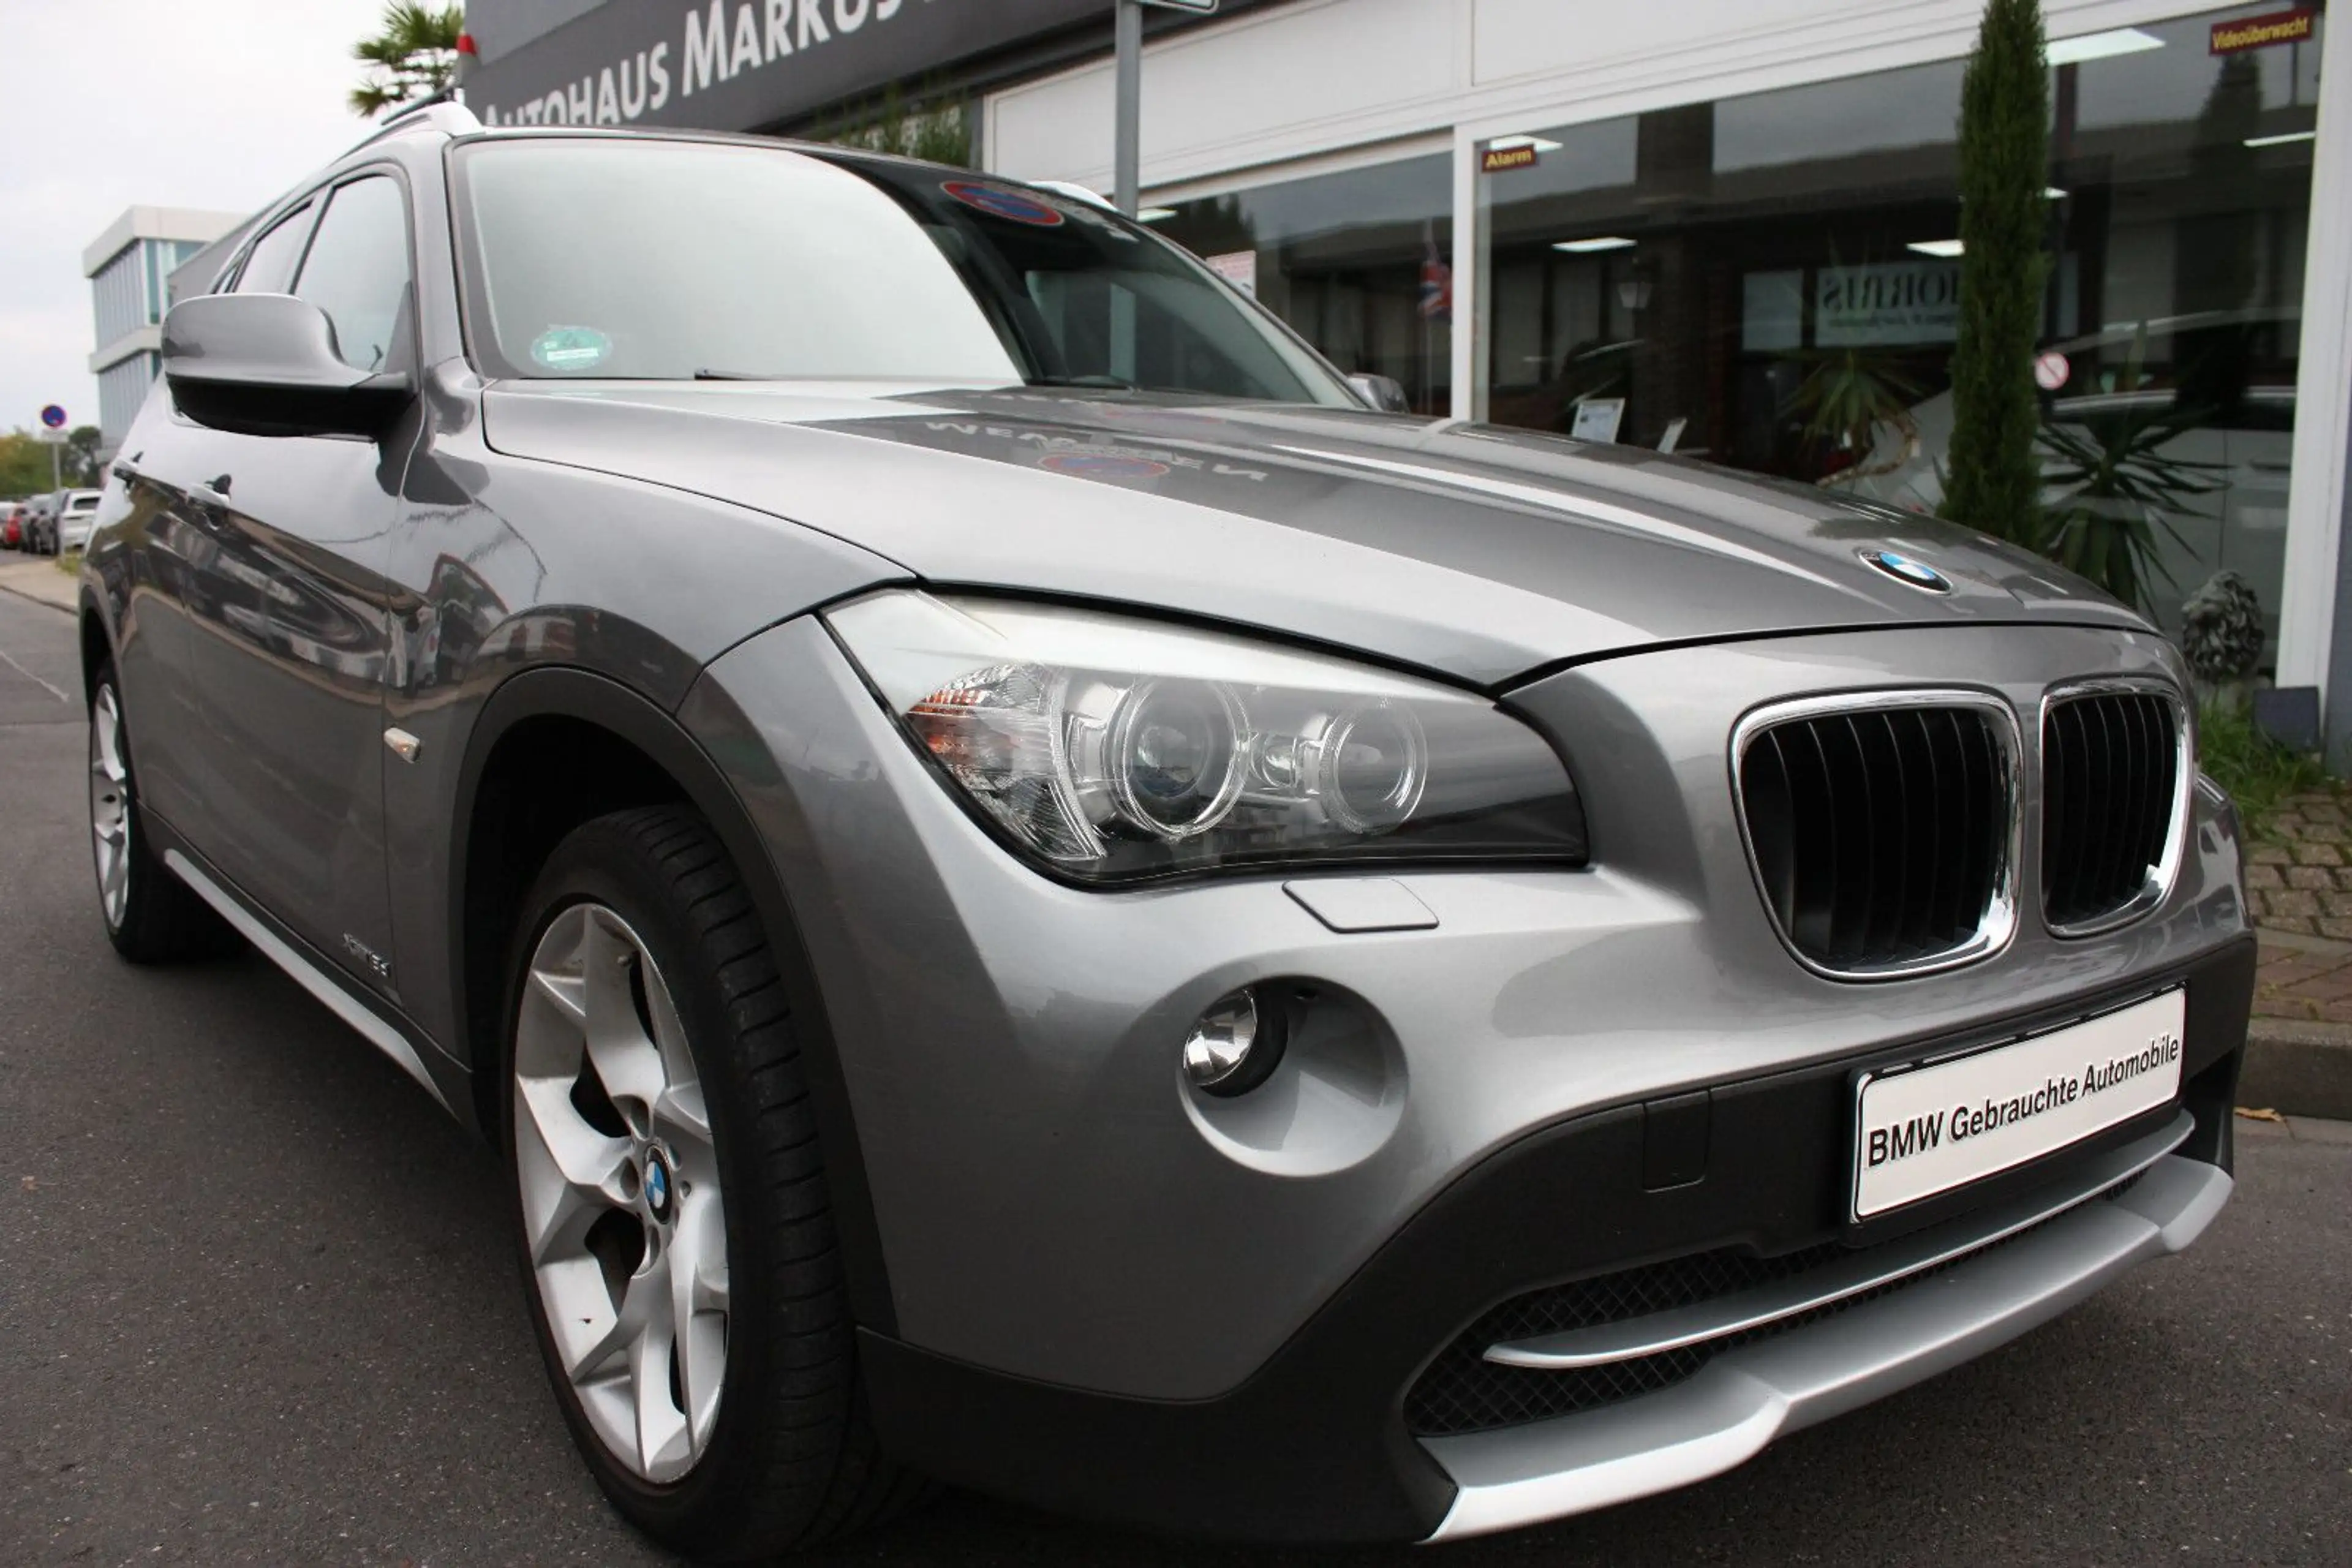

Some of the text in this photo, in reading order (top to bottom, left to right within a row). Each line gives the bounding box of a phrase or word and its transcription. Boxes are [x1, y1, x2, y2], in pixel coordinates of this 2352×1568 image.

[682, 0, 902, 97] MARK
[2212, 17, 2308, 50] Videoüberwacht
[1487, 149, 1531, 168] Alarm
[1868, 1035, 2179, 1168] BMW Gebrauchte Automobile
